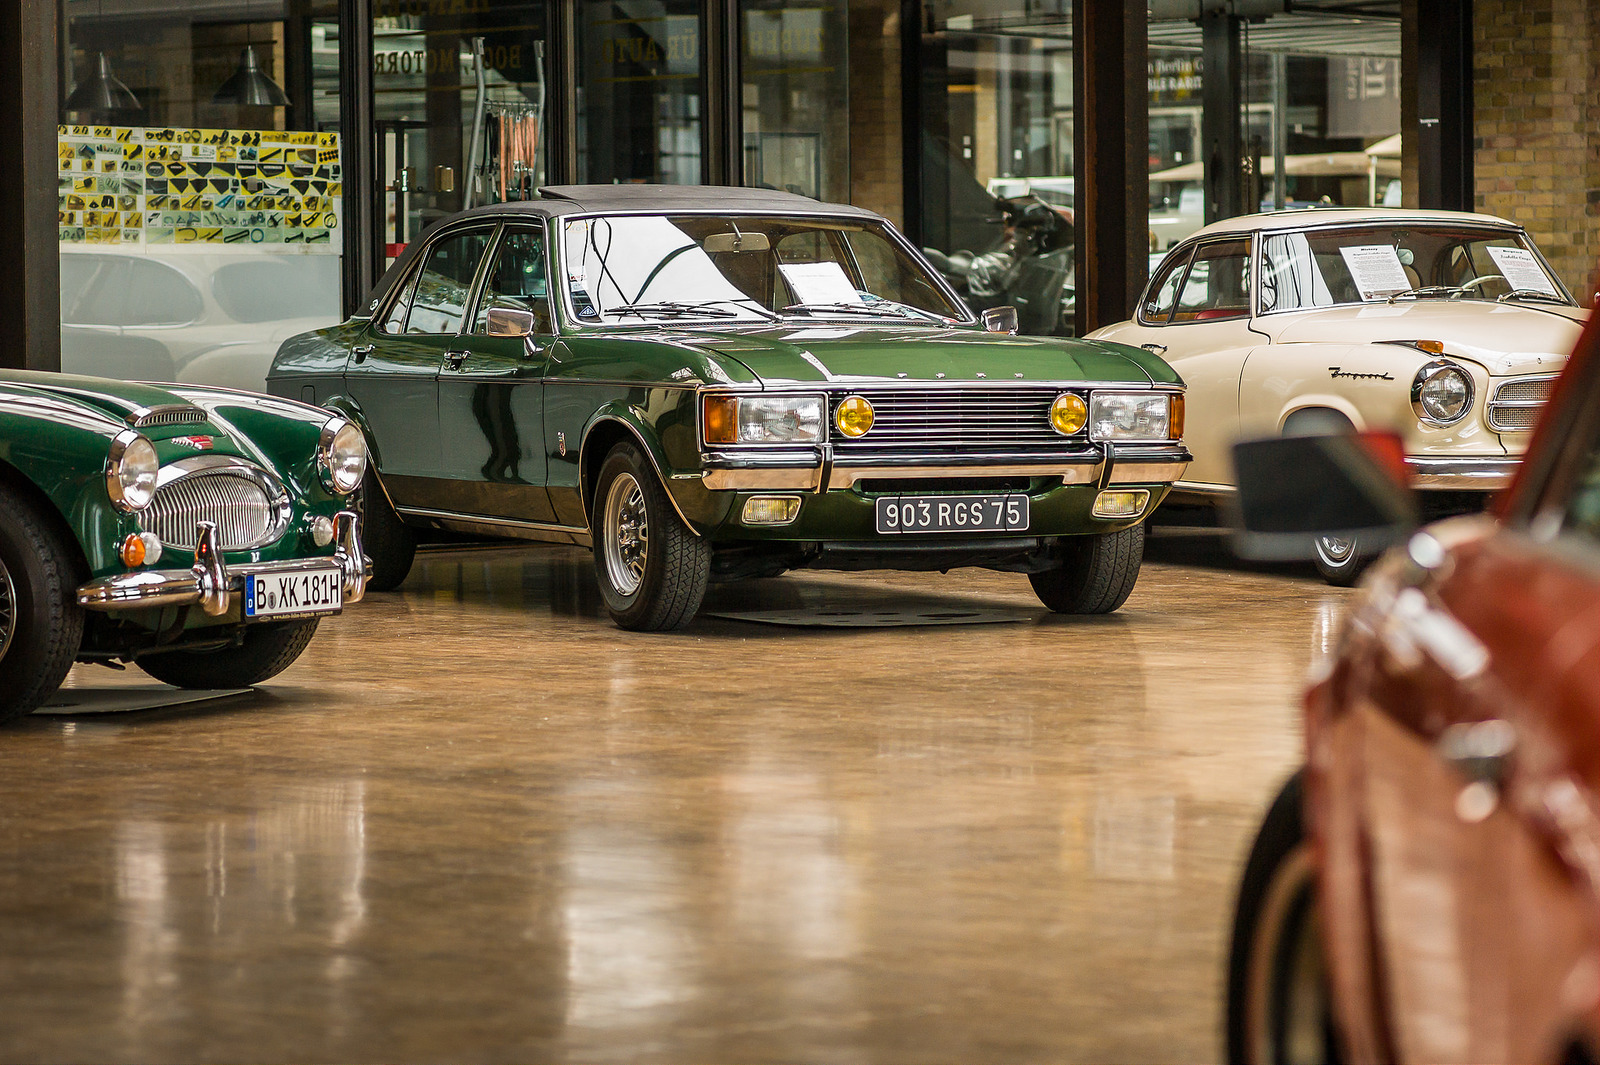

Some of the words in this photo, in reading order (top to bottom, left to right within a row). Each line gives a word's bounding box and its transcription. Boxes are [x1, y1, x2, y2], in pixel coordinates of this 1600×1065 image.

[886, 502, 931, 528] 903
[938, 502, 983, 526] RGS
[991, 501, 1021, 525] 75
[256, 579, 267, 610] B
[278, 576, 299, 608] XK
[302, 573, 339, 606] 181H
